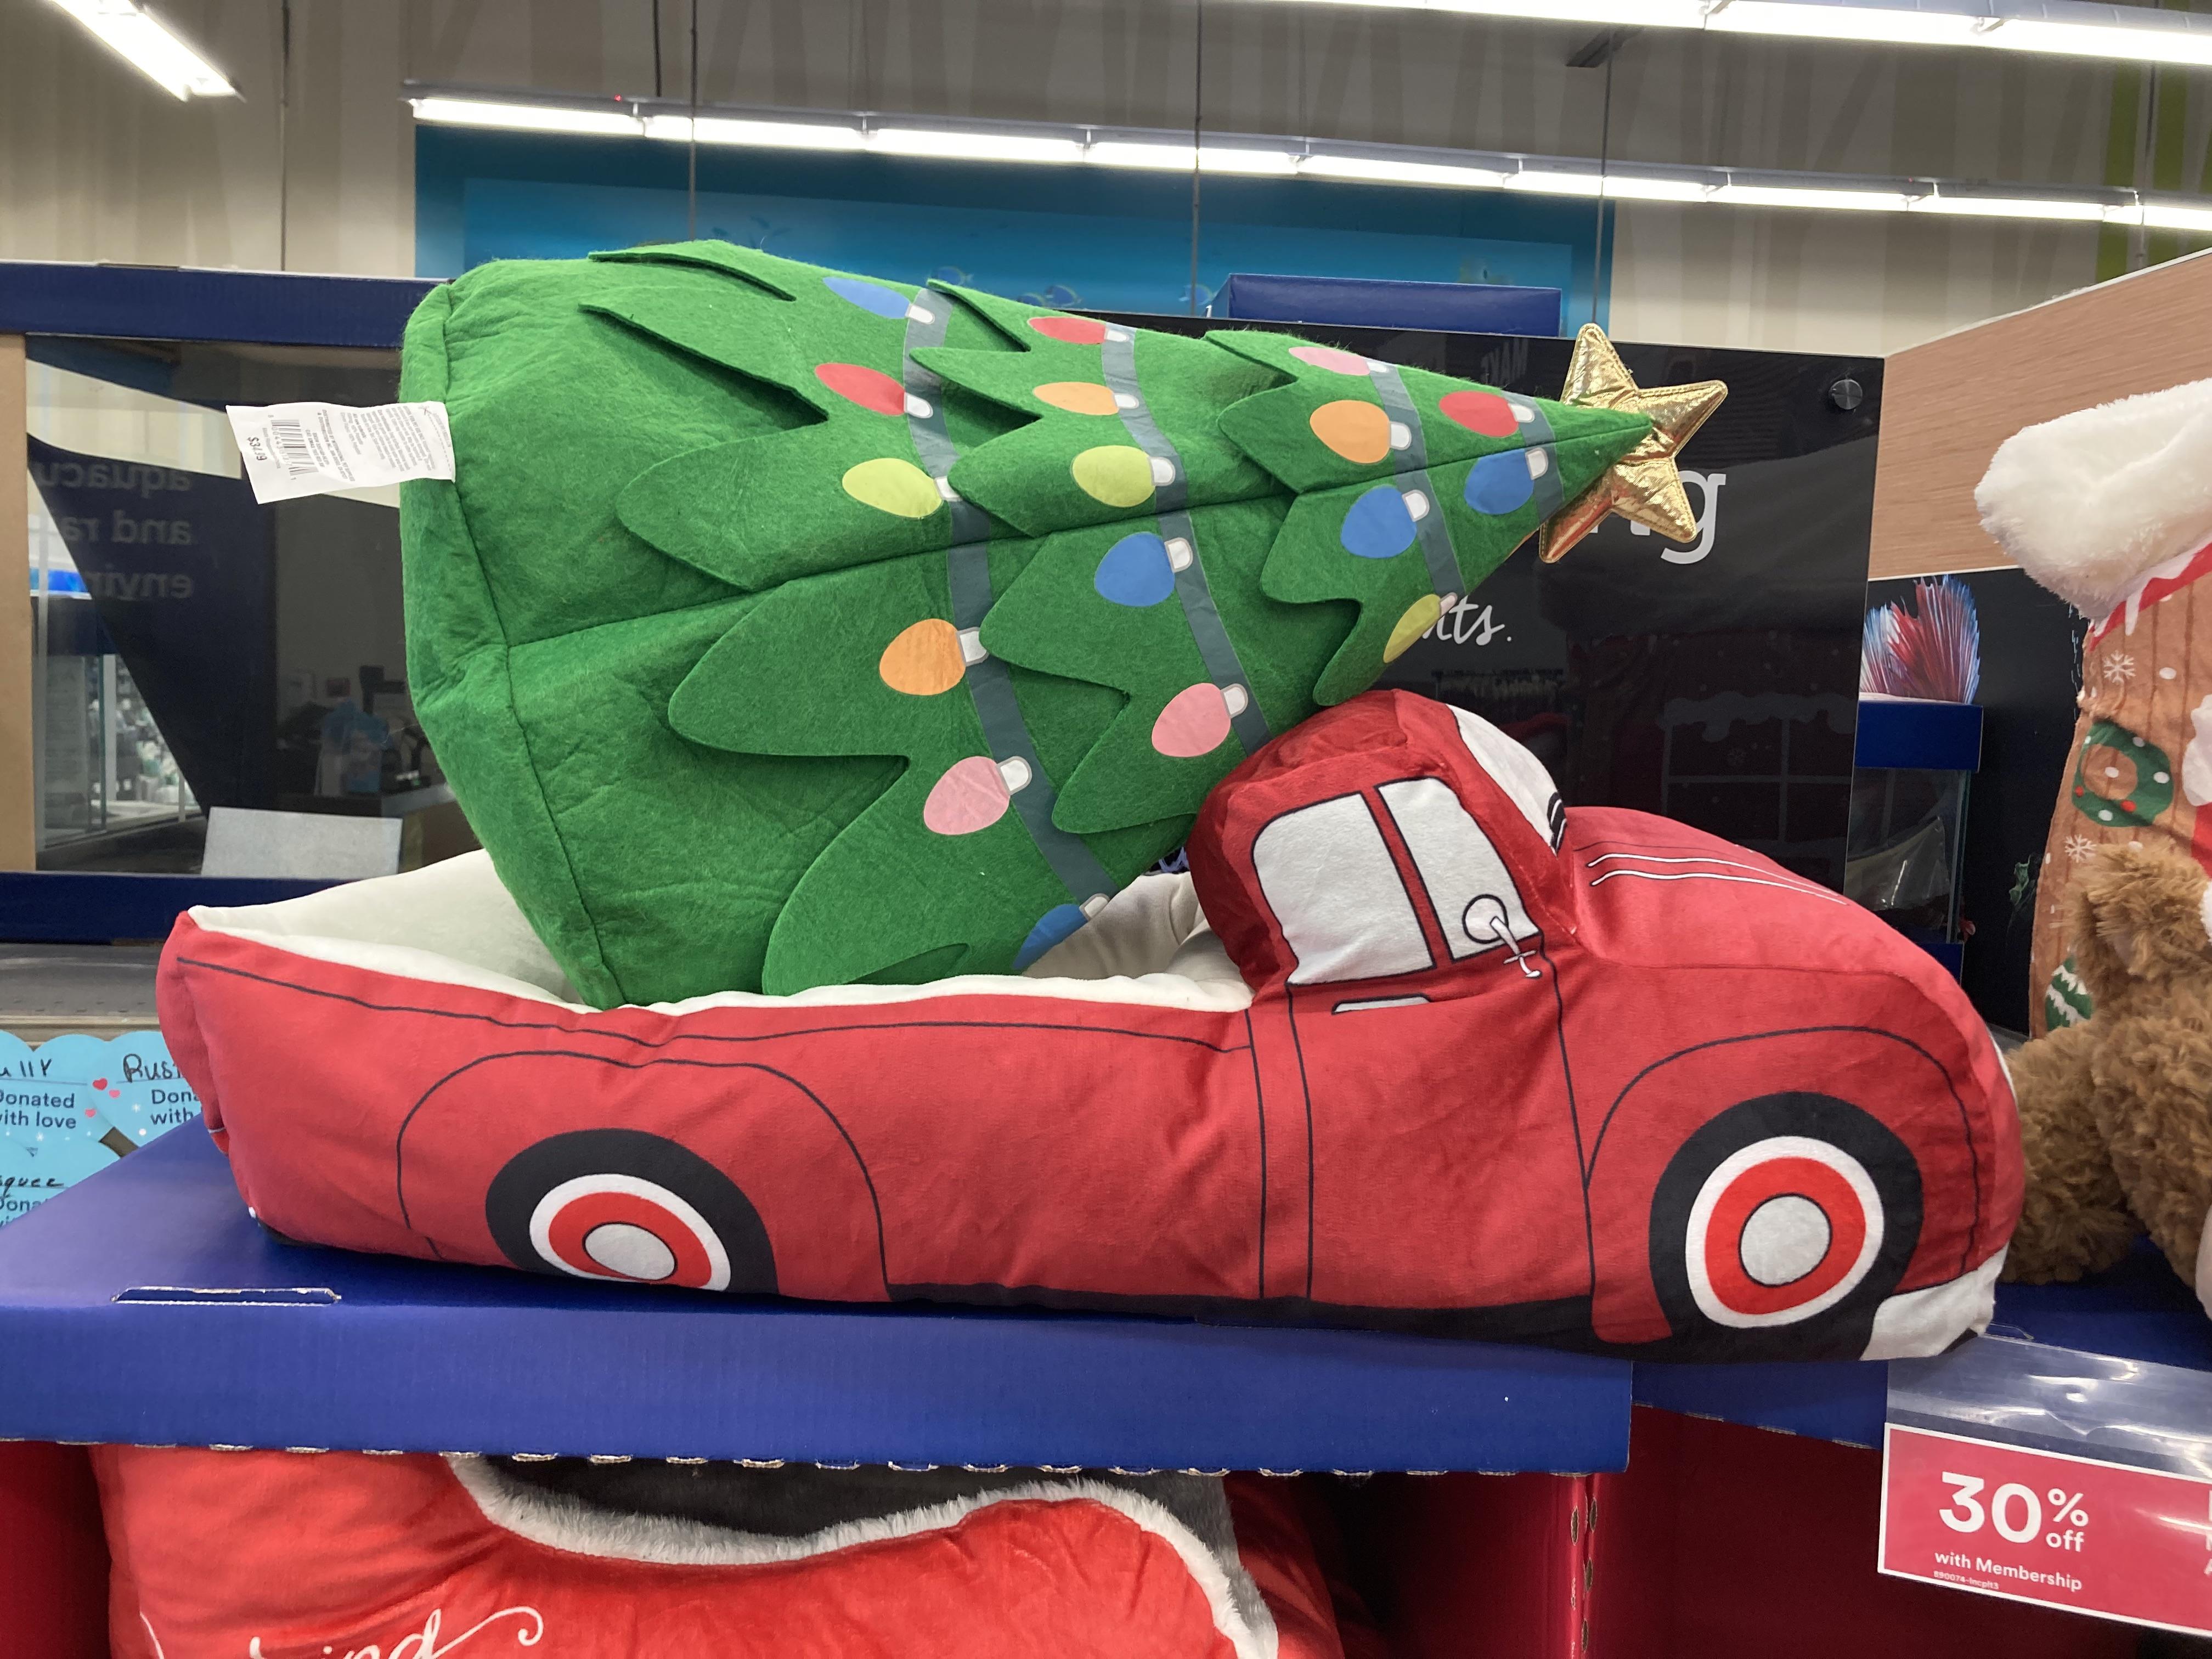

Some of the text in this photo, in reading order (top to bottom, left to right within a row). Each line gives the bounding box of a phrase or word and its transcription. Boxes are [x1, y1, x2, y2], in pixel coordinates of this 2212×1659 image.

[0, 1109, 76, 1128] ith love
[2046, 1530, 2085, 1552] off
[1935, 1552, 2082, 1592] with Membership
